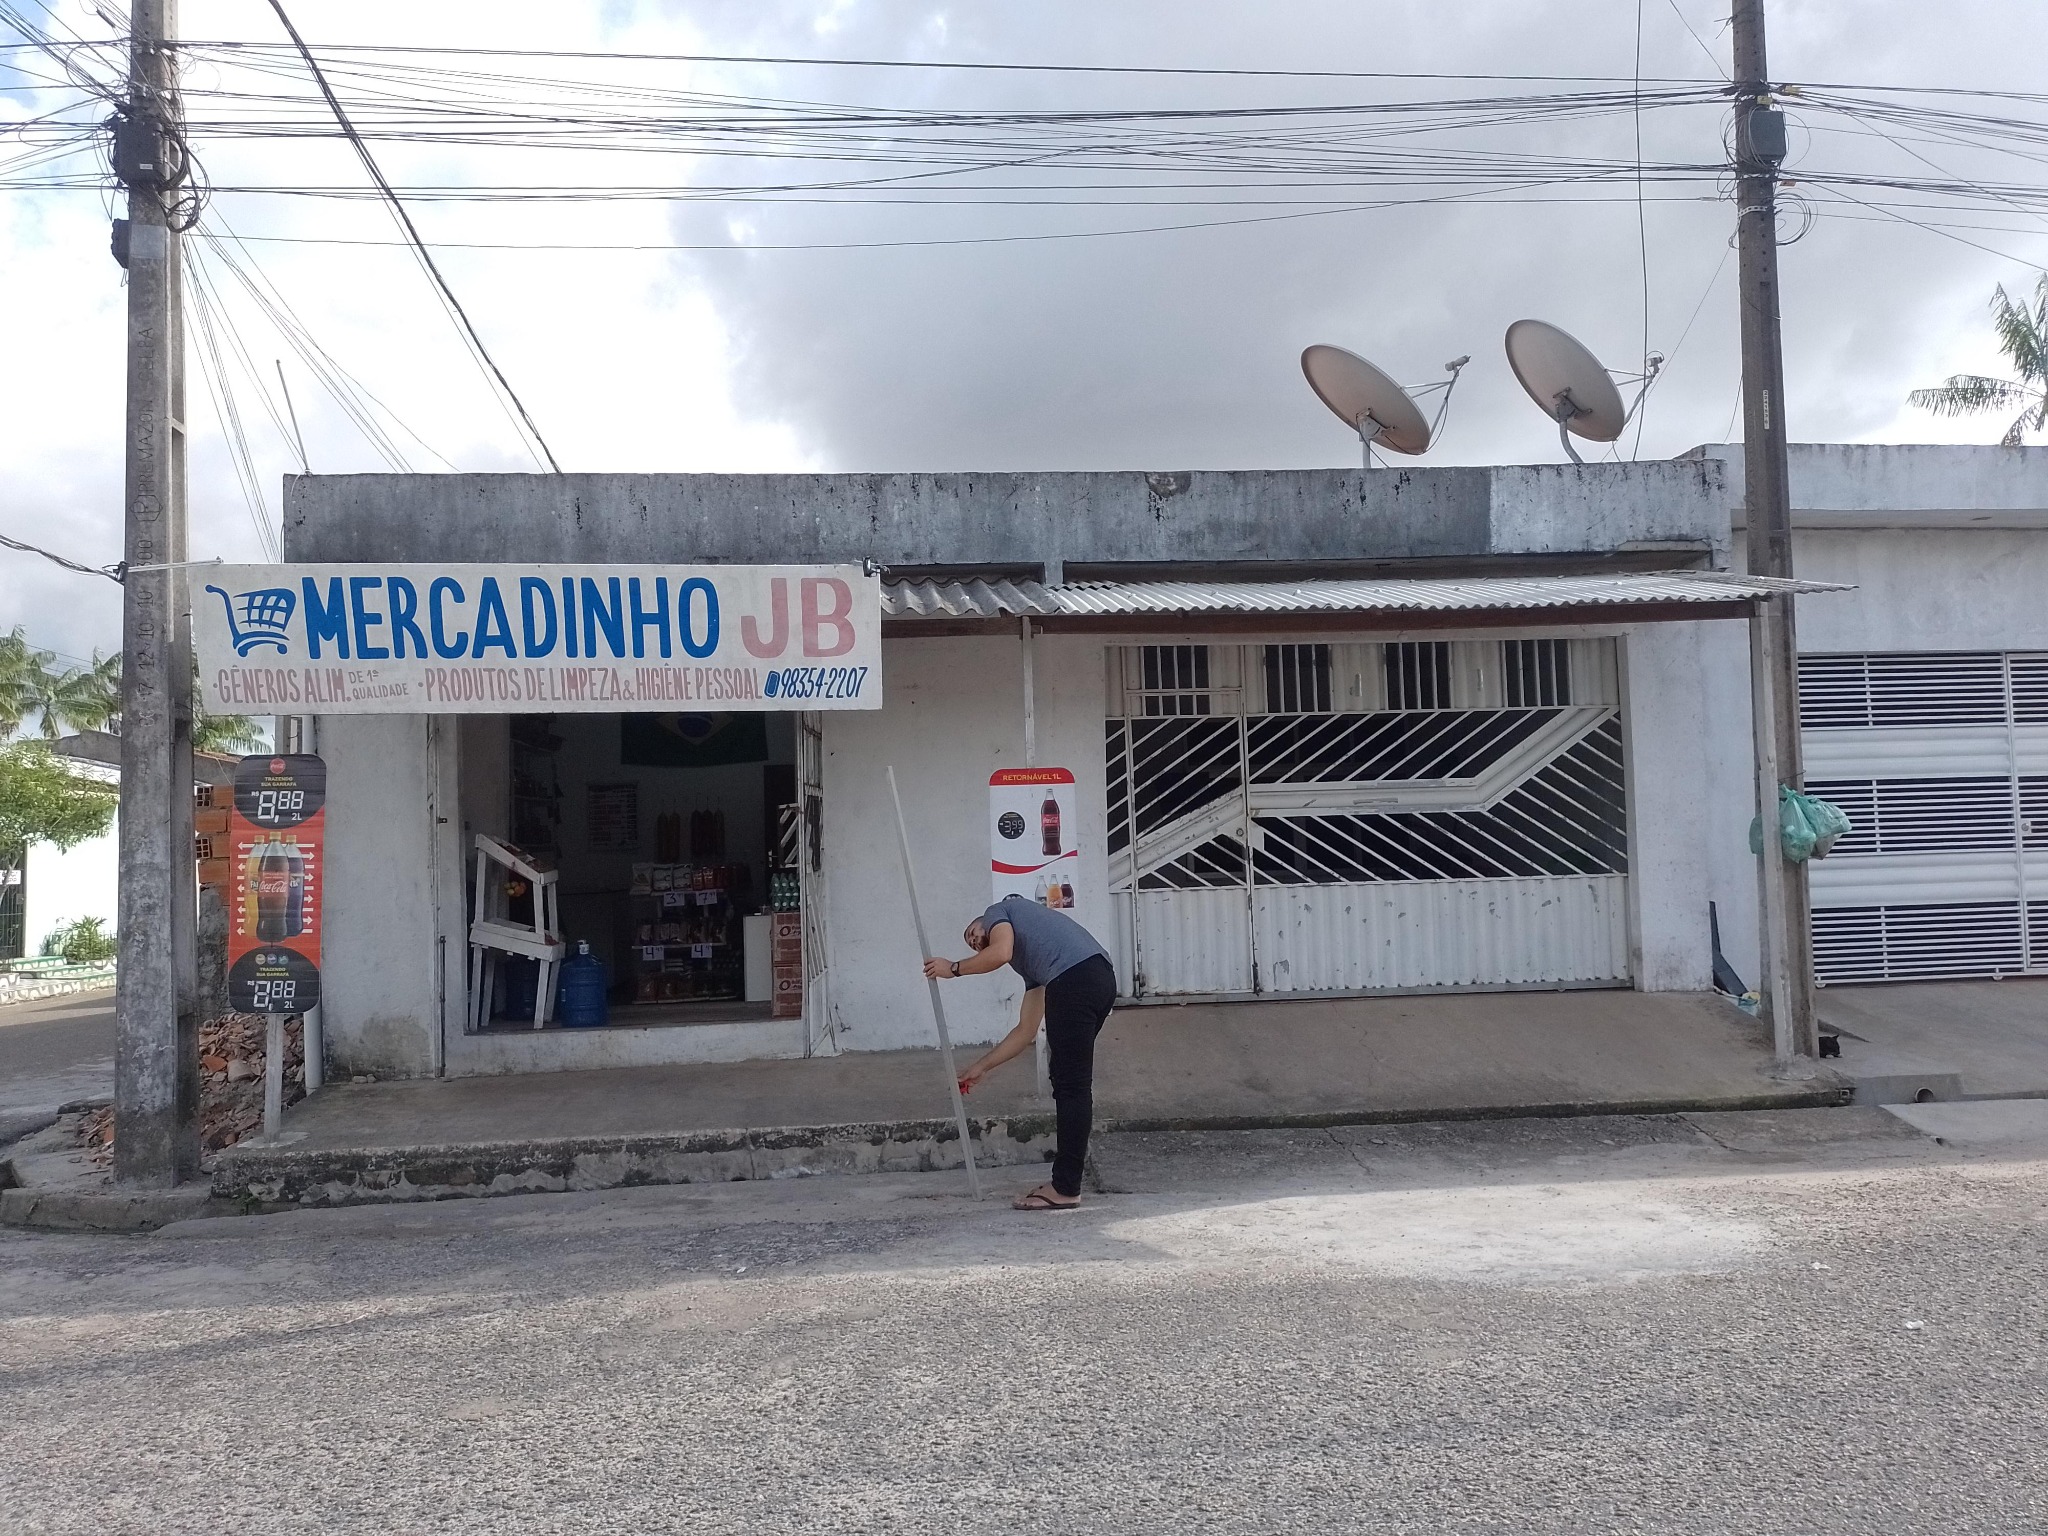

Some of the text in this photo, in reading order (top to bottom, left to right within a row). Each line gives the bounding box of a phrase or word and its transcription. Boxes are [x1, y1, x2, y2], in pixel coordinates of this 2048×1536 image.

[301, 576, 856, 659] MERCADINHO JB
[217, 664, 352, 704] GÊNEROS ALIM.
[348, 671, 363, 684] DE
[424, 662, 763, 702] PRODUTOS DE LIMPEZA & HIGIÊNE PESSOAL
[780, 666, 868, 700] 98354-2207
[352, 682, 409, 700] QUALIDADE
[291, 812, 302, 821] 2L
[284, 1001, 295, 1009] 2L
